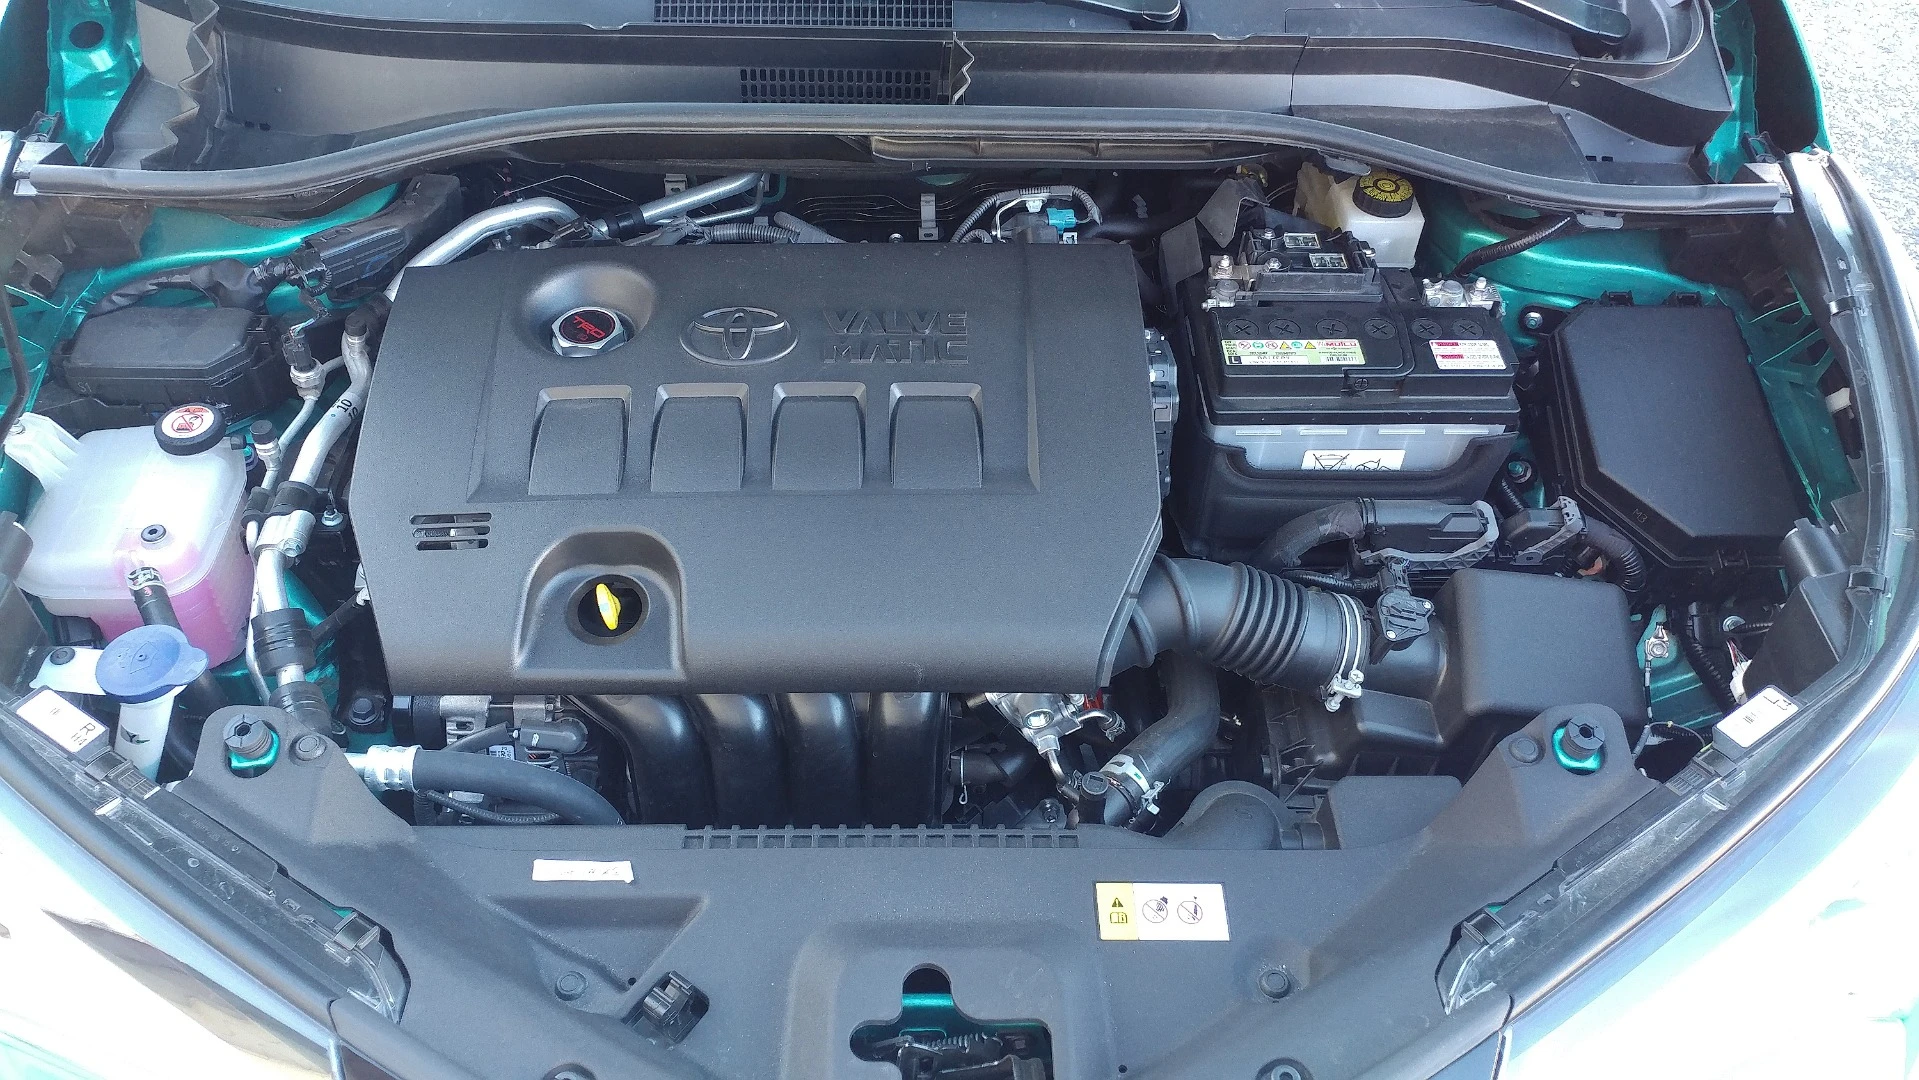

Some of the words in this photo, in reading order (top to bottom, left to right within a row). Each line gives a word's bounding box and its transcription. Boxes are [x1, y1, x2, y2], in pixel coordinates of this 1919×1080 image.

[573, 315, 605, 338] TRD
[823, 310, 968, 336] VALVE
[823, 337, 969, 364] MATIC
[337, 399, 352, 413] 10
